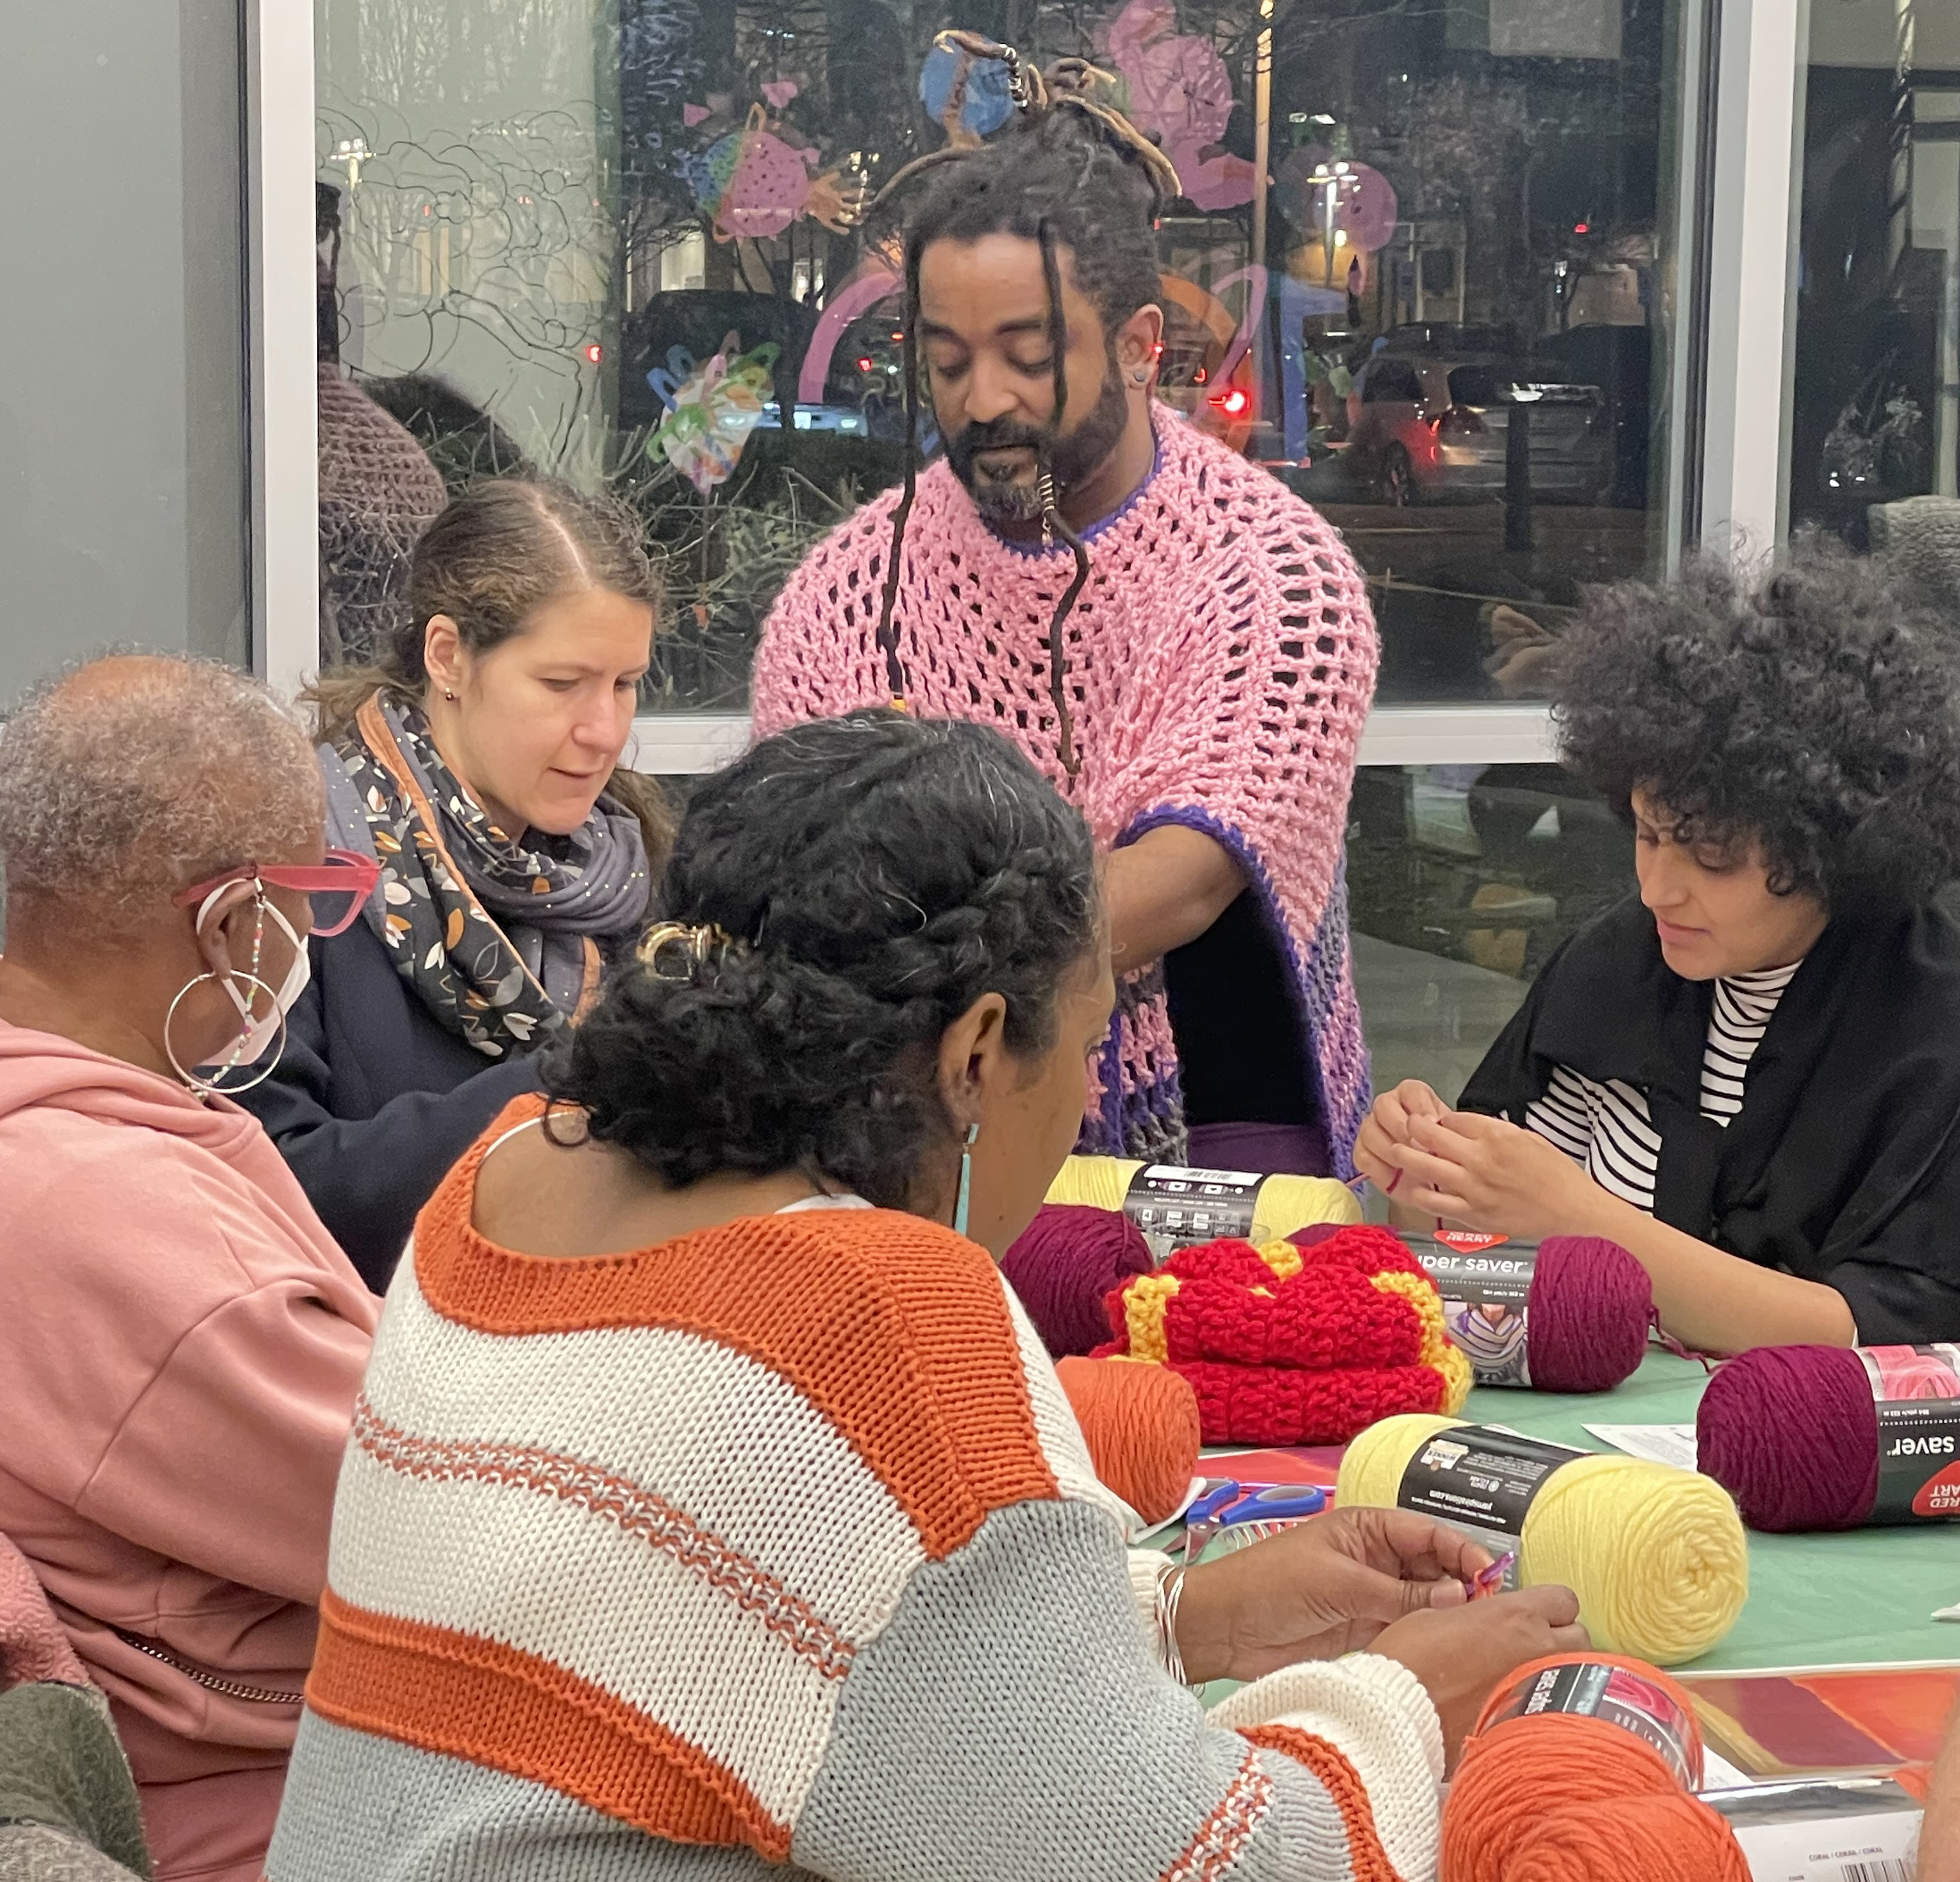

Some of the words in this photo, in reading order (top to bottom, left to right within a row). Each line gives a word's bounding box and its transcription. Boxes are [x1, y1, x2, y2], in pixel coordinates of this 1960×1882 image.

[1891, 1436, 1954, 1456] saver
[1930, 1485, 1960, 1498] ART
[1930, 1496, 1960, 1509] RED
